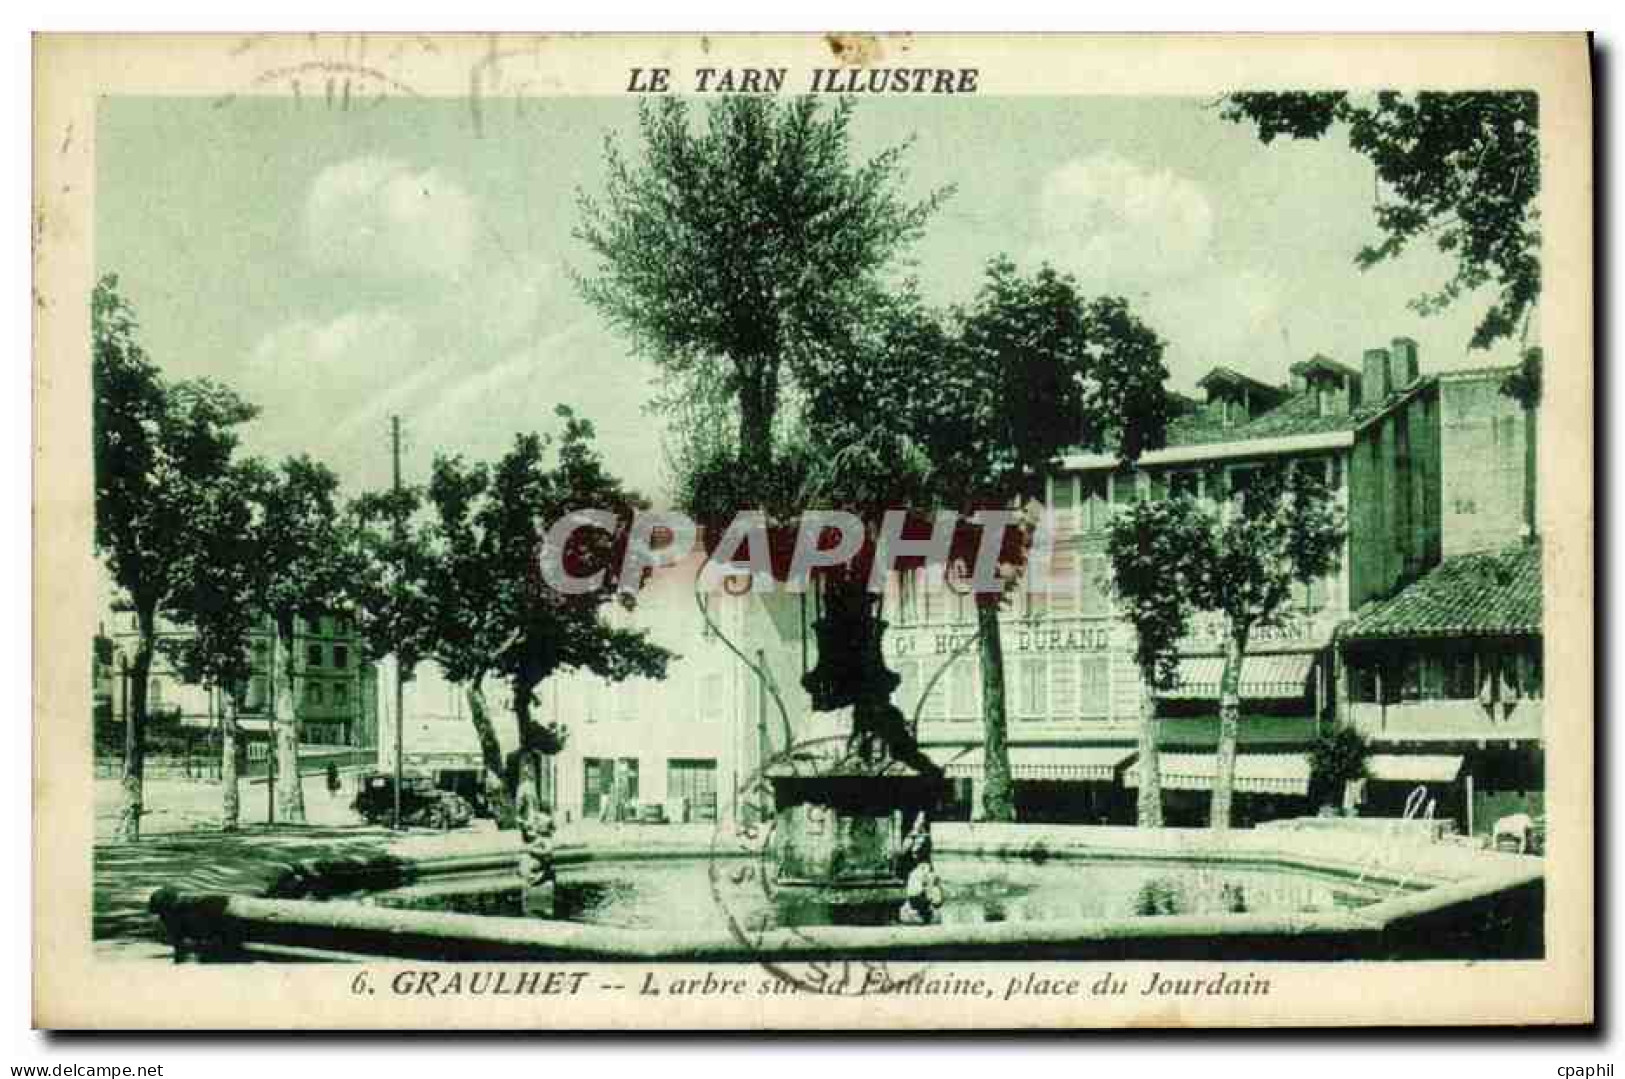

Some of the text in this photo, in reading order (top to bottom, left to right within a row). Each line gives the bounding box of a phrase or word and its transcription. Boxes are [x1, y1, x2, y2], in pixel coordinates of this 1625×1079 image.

[626, 68, 980, 94] LE TARN ILLUSTRE
[1016, 628, 1107, 652] DURAND
[350, 972, 375, 996] 6.
[391, 970, 590, 996] GRAULHET
[669, 971, 747, 996] arbre
[1004, 970, 1079, 1000] place
[1092, 970, 1128, 996] du
[1140, 970, 1271, 998] Jourdain
